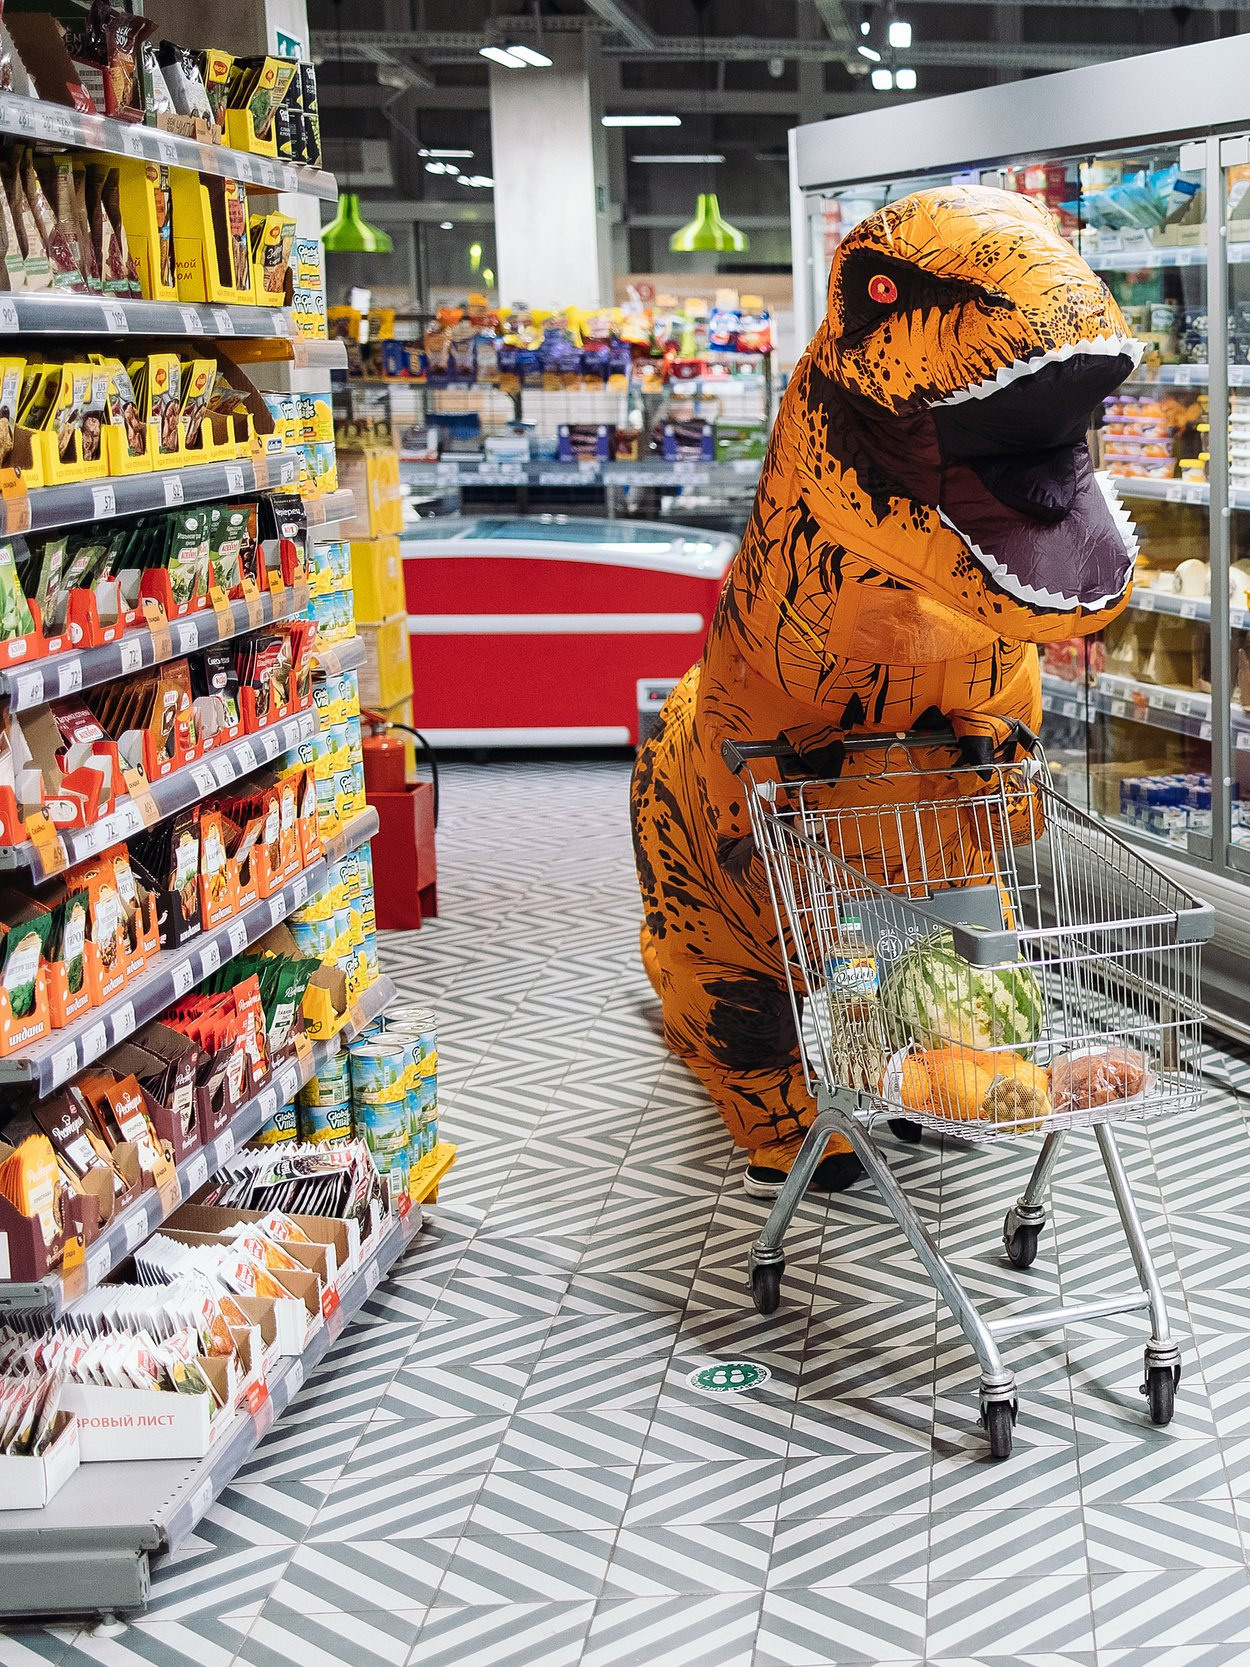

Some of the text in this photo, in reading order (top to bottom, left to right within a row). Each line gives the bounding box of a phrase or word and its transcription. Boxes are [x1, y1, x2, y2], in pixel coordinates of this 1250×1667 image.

[211, 905, 232, 924] индана
[126, 956, 144, 976] индана
[103, 974, 124, 997] индана
[66, 993, 88, 1016] индана
[9, 1021, 44, 1047] индана
[77, 1415, 175, 1429] ВРОВЫЙ ЛИСТ
